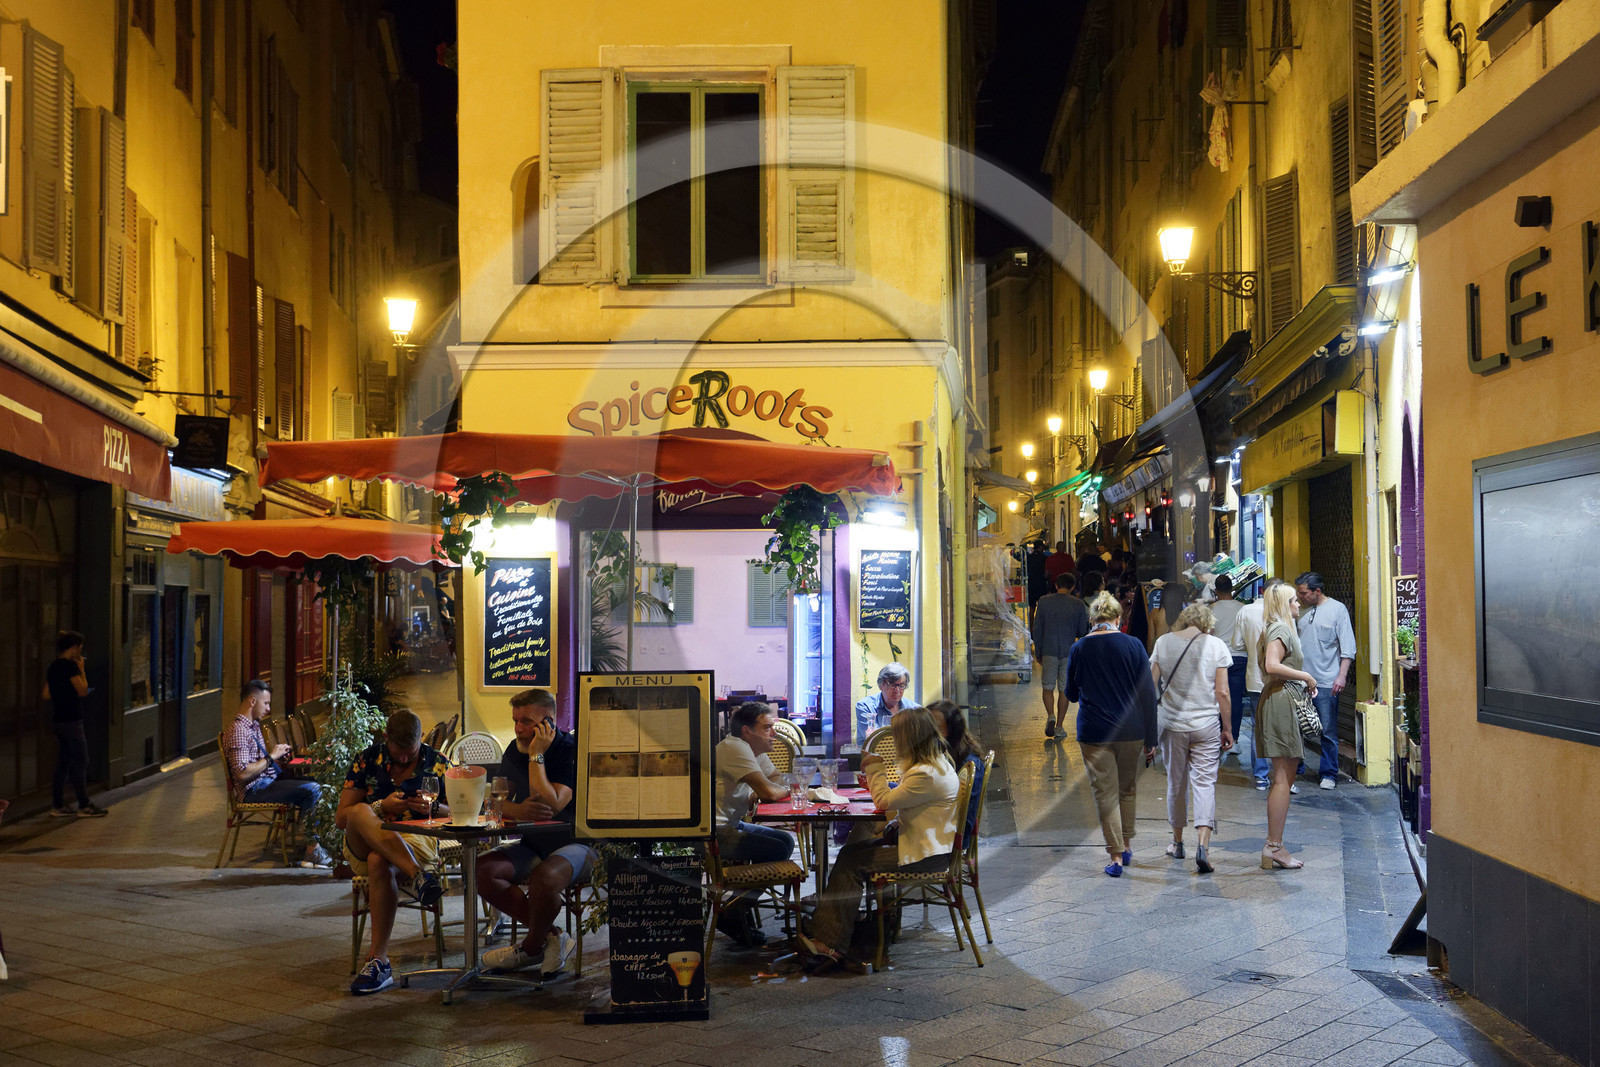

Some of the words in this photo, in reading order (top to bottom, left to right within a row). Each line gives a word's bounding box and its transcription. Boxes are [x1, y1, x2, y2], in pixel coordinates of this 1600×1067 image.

[103, 424, 132, 475] PIZZA
[490, 566, 535, 587] Pizza
[488, 585, 536, 608] Cuisine
[497, 608, 534, 627] Familiale
[517, 619, 527, 628] de
[488, 639, 526, 658] Traditional
[526, 636, 546, 650] family
[506, 663, 534, 674] burning
[615, 675, 673, 686] MENU
[614, 873, 648, 886] Affligem
[657, 885, 690, 895] FARCIS
[624, 963, 646, 972] CHEF
